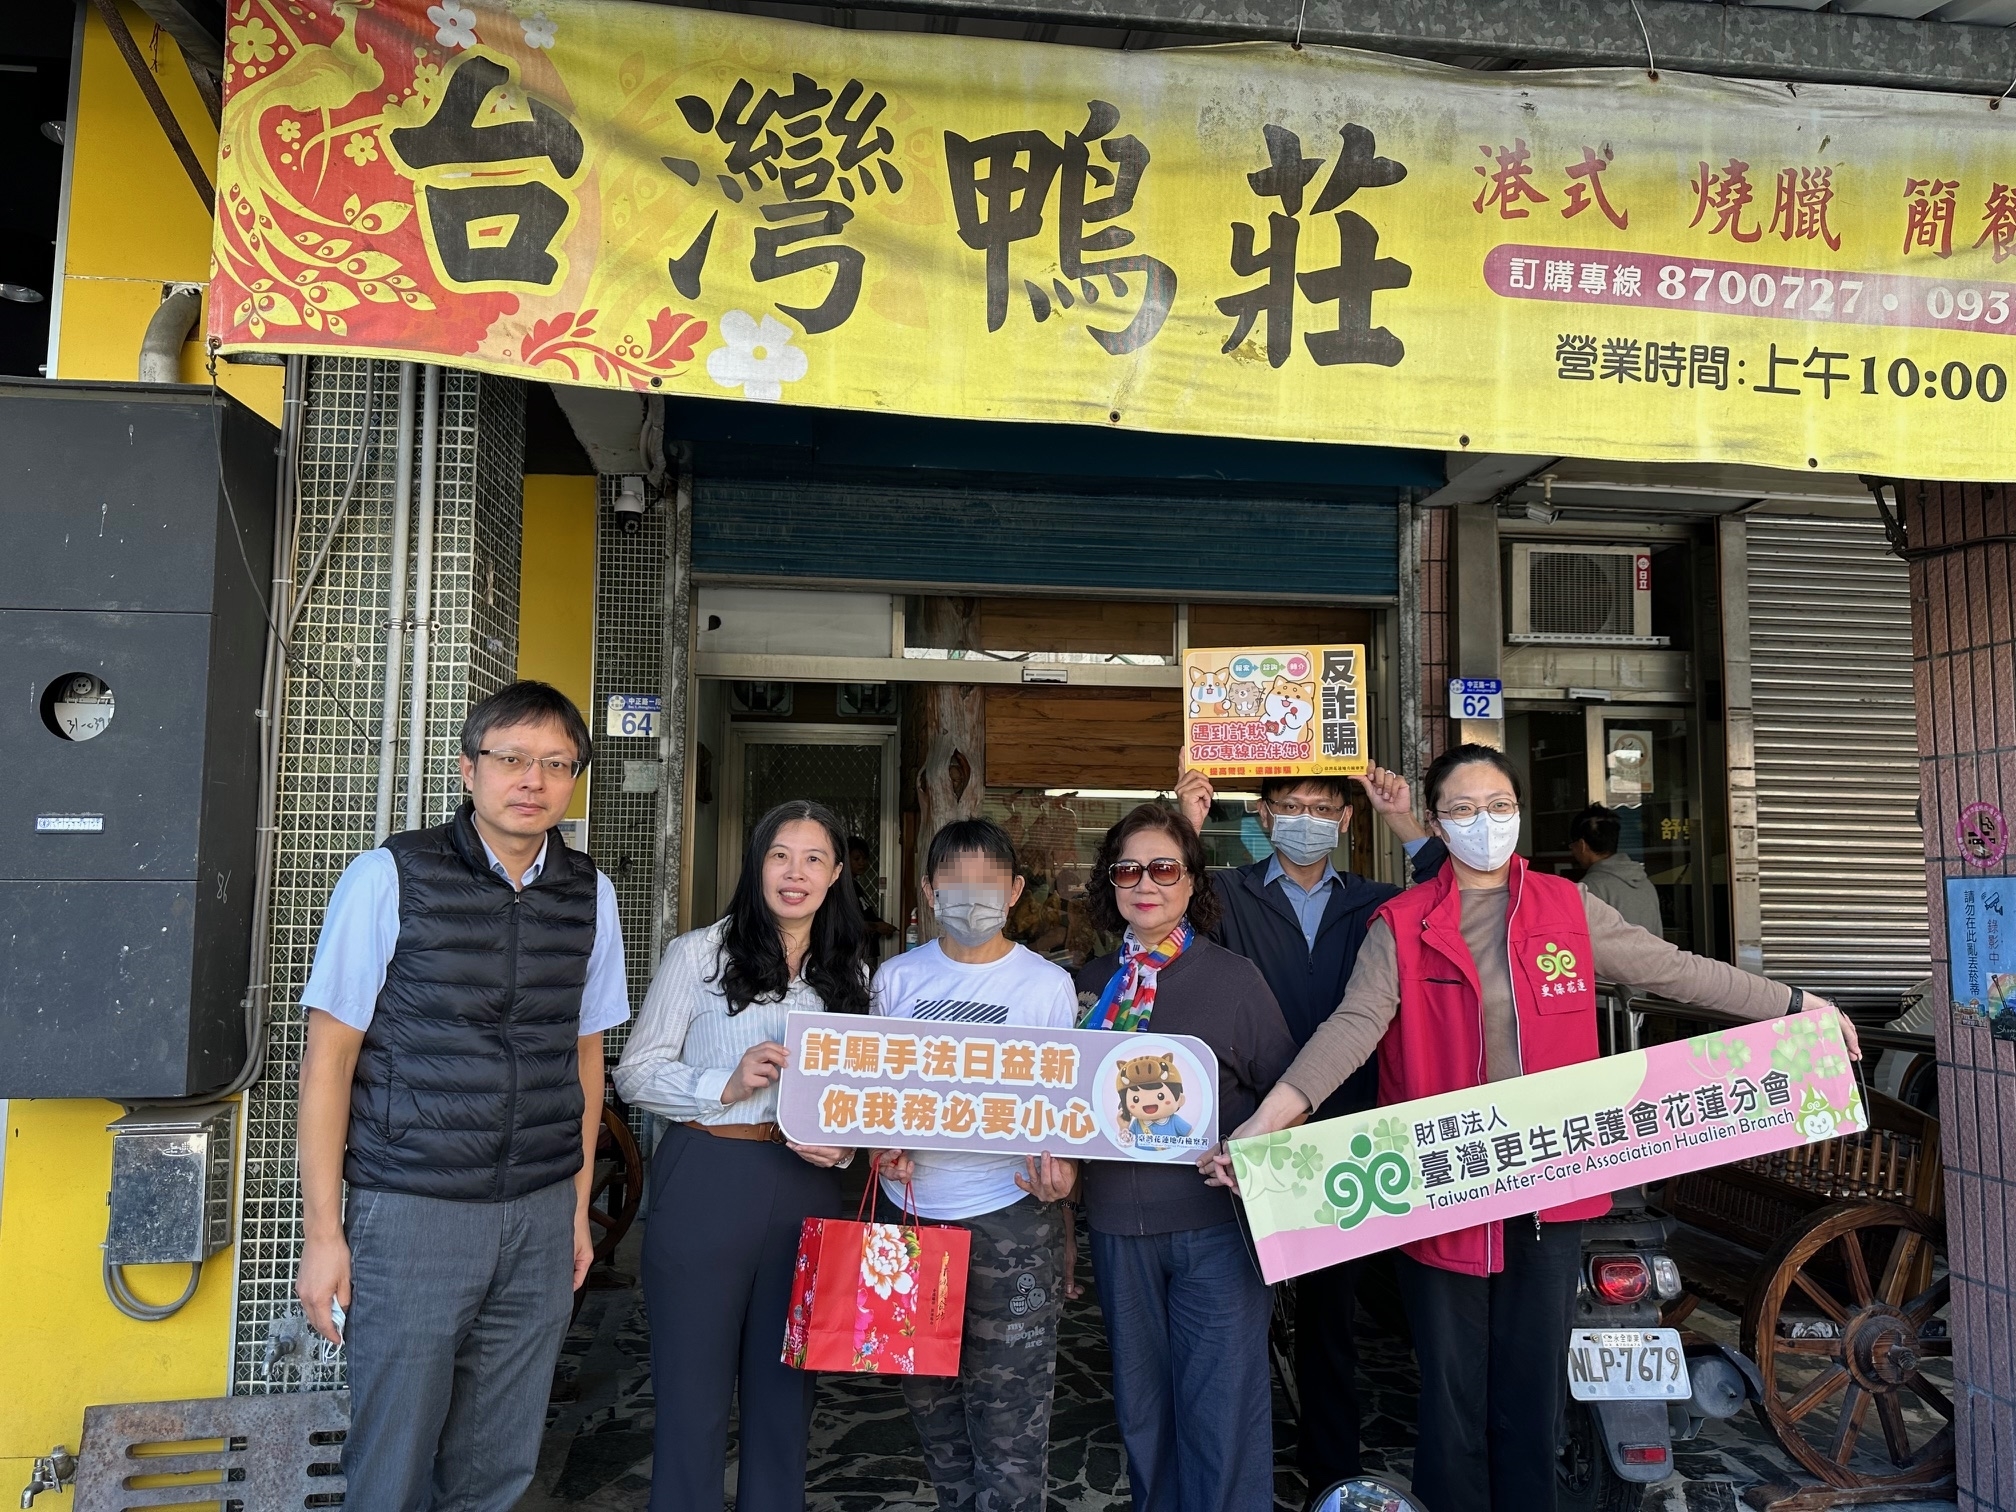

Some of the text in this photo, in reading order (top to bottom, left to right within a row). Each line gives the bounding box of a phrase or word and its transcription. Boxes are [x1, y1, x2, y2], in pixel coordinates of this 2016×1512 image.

[390, 55, 1412, 368] 台灣鴨莊
[1472, 137, 1628, 230] 港式
[1689, 157, 1841, 251] 燒臘
[1509, 257, 1642, 298] 訂購專線
[1656, 264, 1864, 315] 8700727
[621, 712, 653, 735] 64
[1321, 650, 1358, 755] 反詐騙
[1463, 695, 1490, 717] 62
[1193, 723, 1265, 741] 遇到詐欺
[1964, 890, 1980, 996] 請勿在此亂丟菸蒂
[1987, 919, 2000, 966] 錄影中
[1541, 978, 1587, 997] 更保花蓮
[803, 1031, 1077, 1085] 詐騙手法日益新
[822, 1087, 1096, 1140] 你我務必要小心
[1414, 1105, 1508, 1147] 財團法人
[1418, 1069, 1791, 1189] 臺灣更生保護會花蓮分會
[1426, 1108, 1795, 1209] Taiwan After-Care Association Hualien Branch
[1005, 1326, 1045, 1348] people
[1007, 1322, 1024, 1331] my
[1024, 1339, 1043, 1349] are
[1568, 1347, 1680, 1382] NLP-7679
